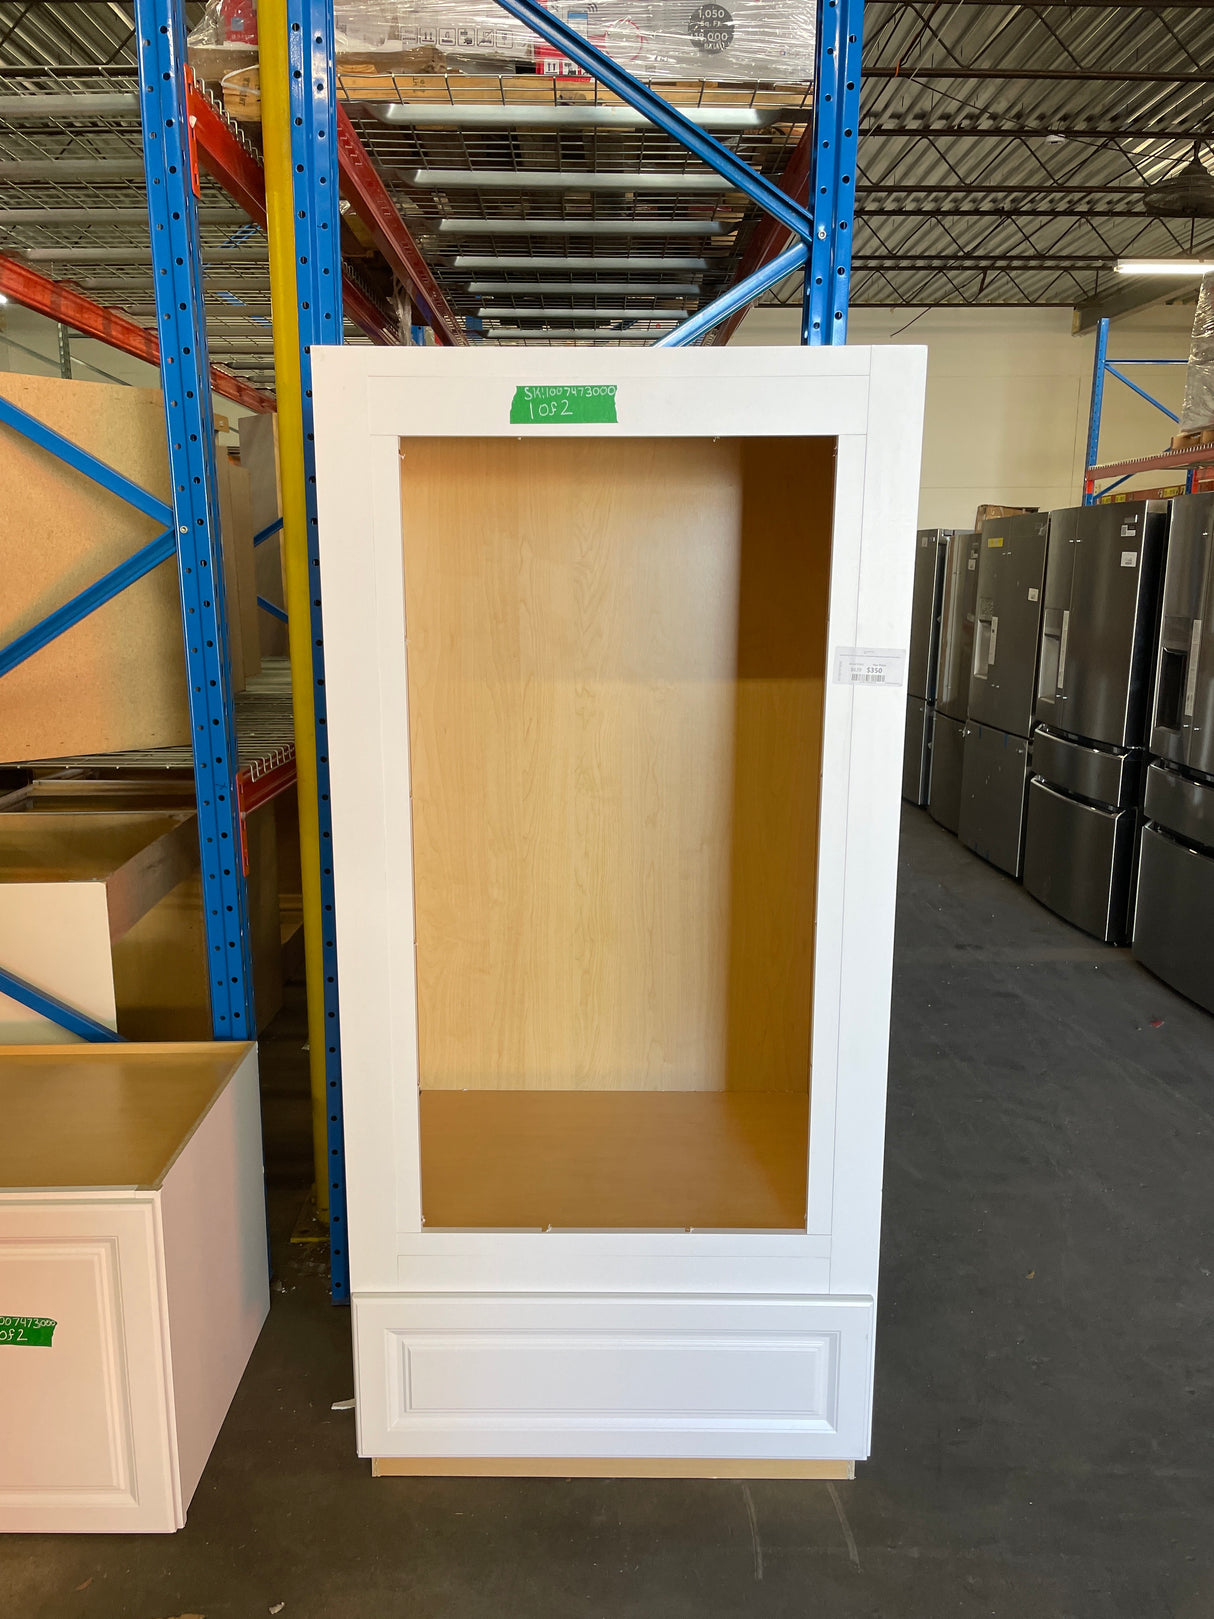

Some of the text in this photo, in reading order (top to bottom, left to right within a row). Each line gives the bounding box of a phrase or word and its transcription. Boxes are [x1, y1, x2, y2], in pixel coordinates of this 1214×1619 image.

[698, 9, 725, 19] 1,050
[560, 399, 574, 416] 2
[866, 666, 883, 674] $350
[17, 1328, 28, 1341] 2
